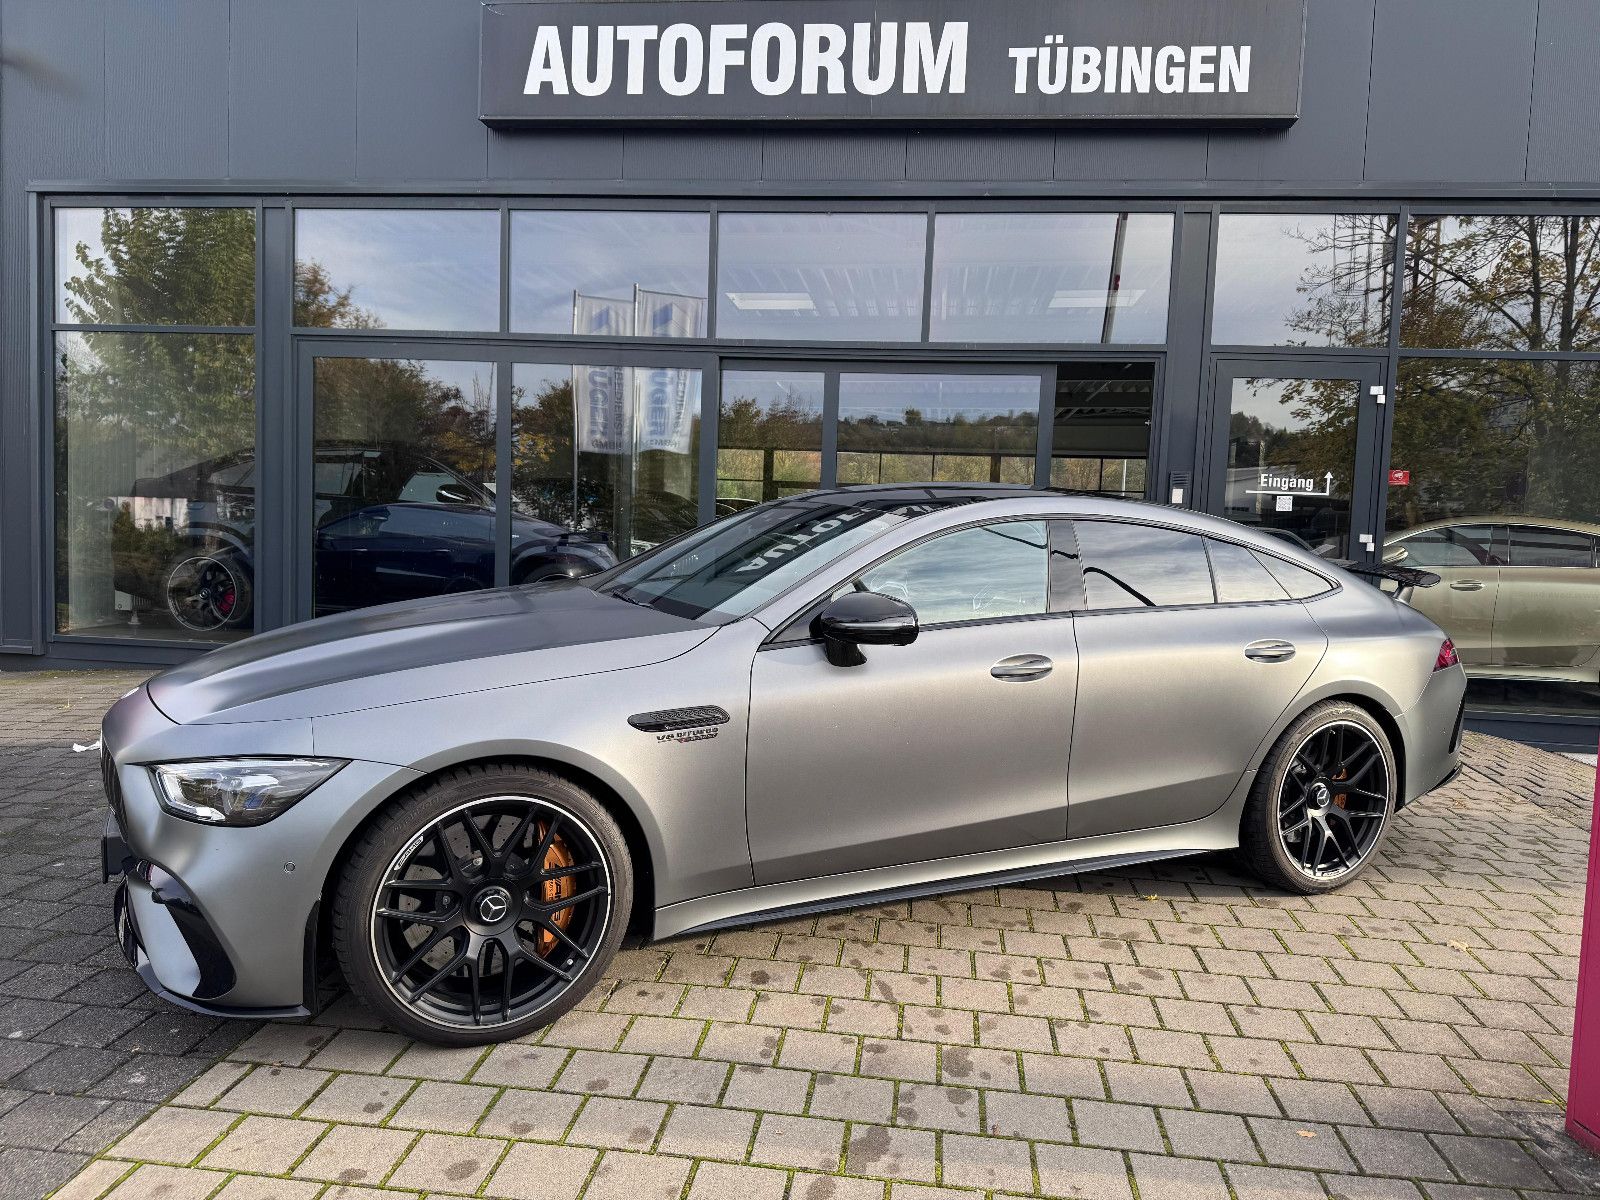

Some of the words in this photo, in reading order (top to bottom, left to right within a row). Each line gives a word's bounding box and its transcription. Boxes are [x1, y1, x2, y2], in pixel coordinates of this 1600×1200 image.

[523, 21, 969, 97] AUTOFORUM
[1008, 34, 1252, 95] TÜBINGEN
[1260, 473, 1314, 492] Eingang
